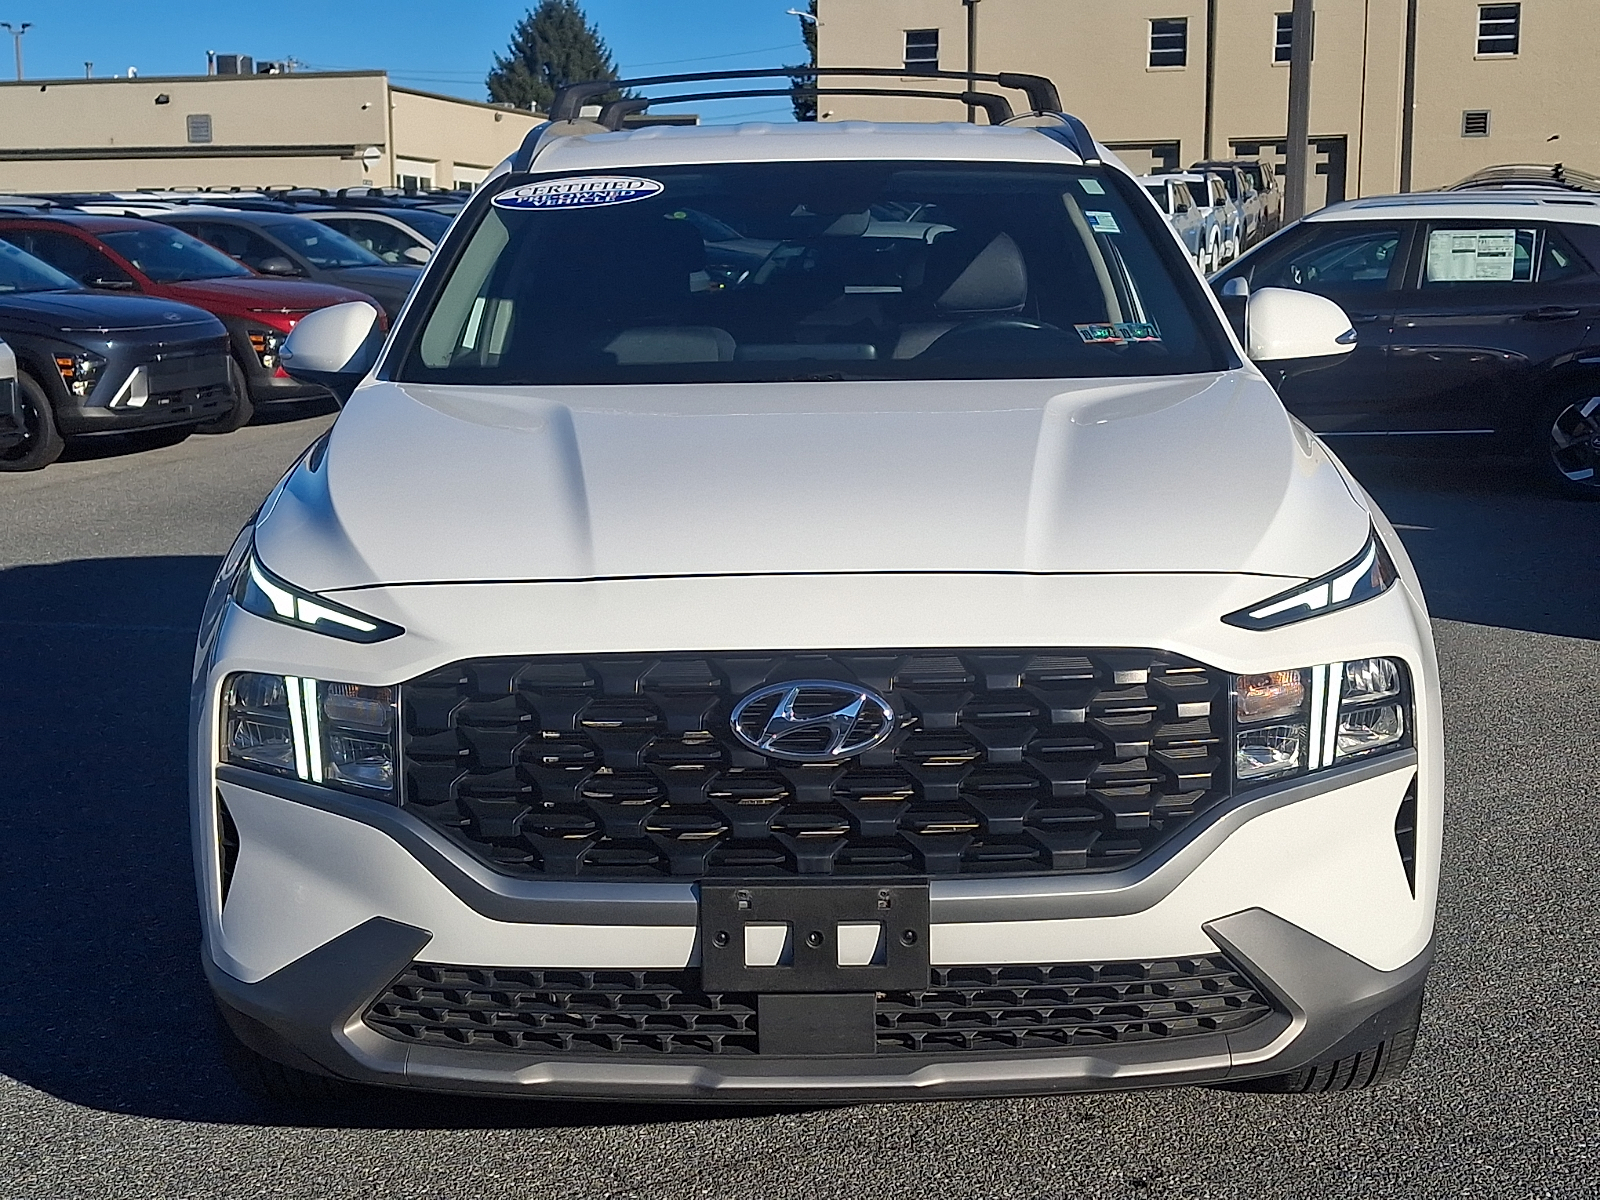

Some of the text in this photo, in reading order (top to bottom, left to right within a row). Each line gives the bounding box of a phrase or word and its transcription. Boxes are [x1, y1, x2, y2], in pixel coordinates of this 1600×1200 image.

[514, 181, 645, 197] CERTIFIED
[516, 190, 636, 203] PRE-OWNED
[532, 195, 617, 207] VEHICLE
